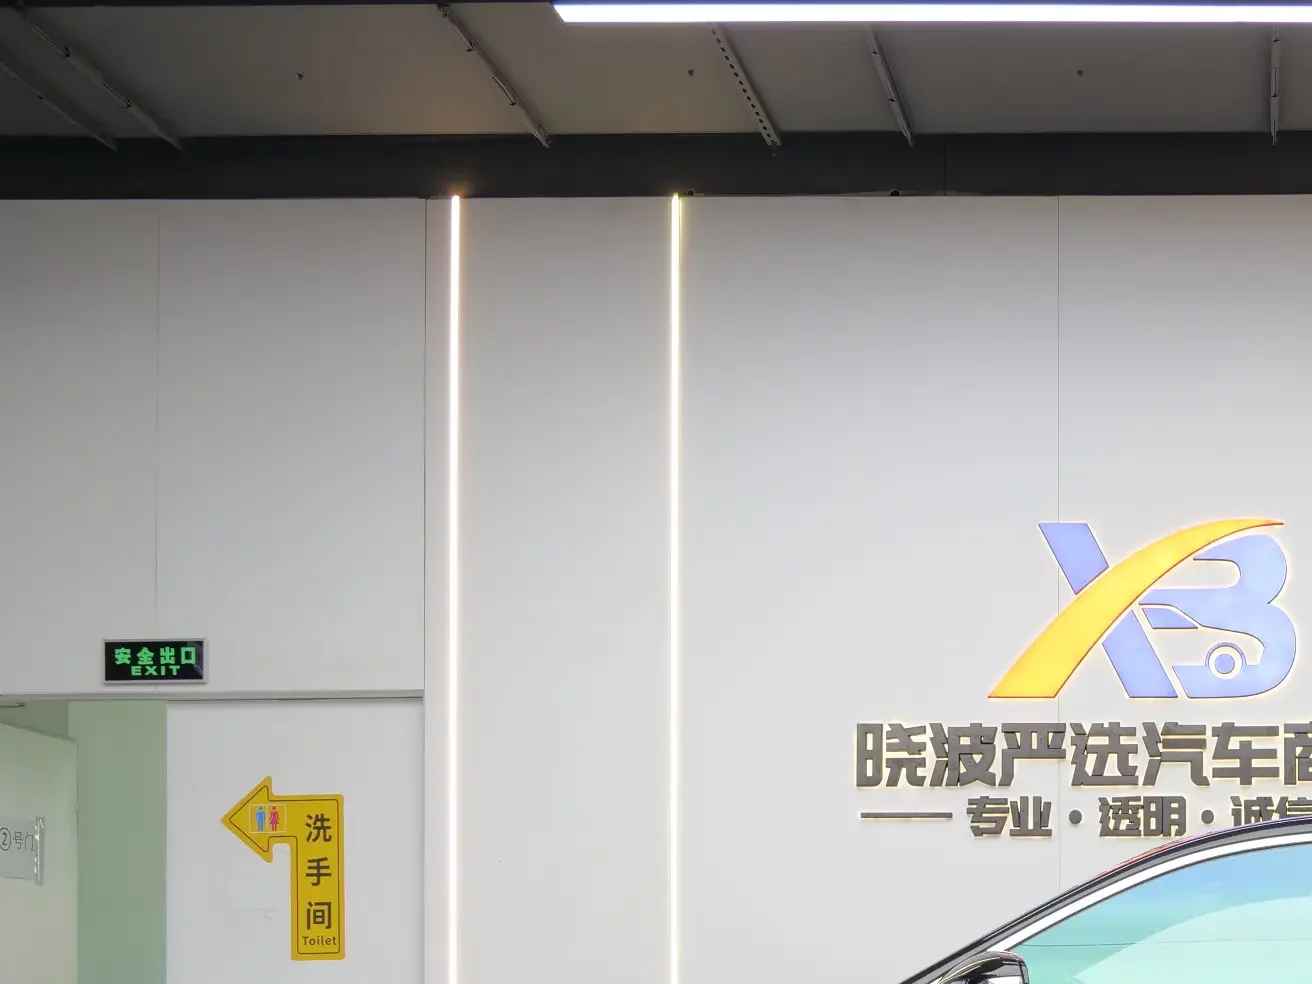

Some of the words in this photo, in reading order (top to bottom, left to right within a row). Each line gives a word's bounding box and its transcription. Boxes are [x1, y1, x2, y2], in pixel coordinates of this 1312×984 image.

[114, 646, 196, 665] 安全出口
[131, 665, 181, 676] EXIT
[305, 813, 332, 930] 洗手间
[302, 936, 337, 947] Toilet
